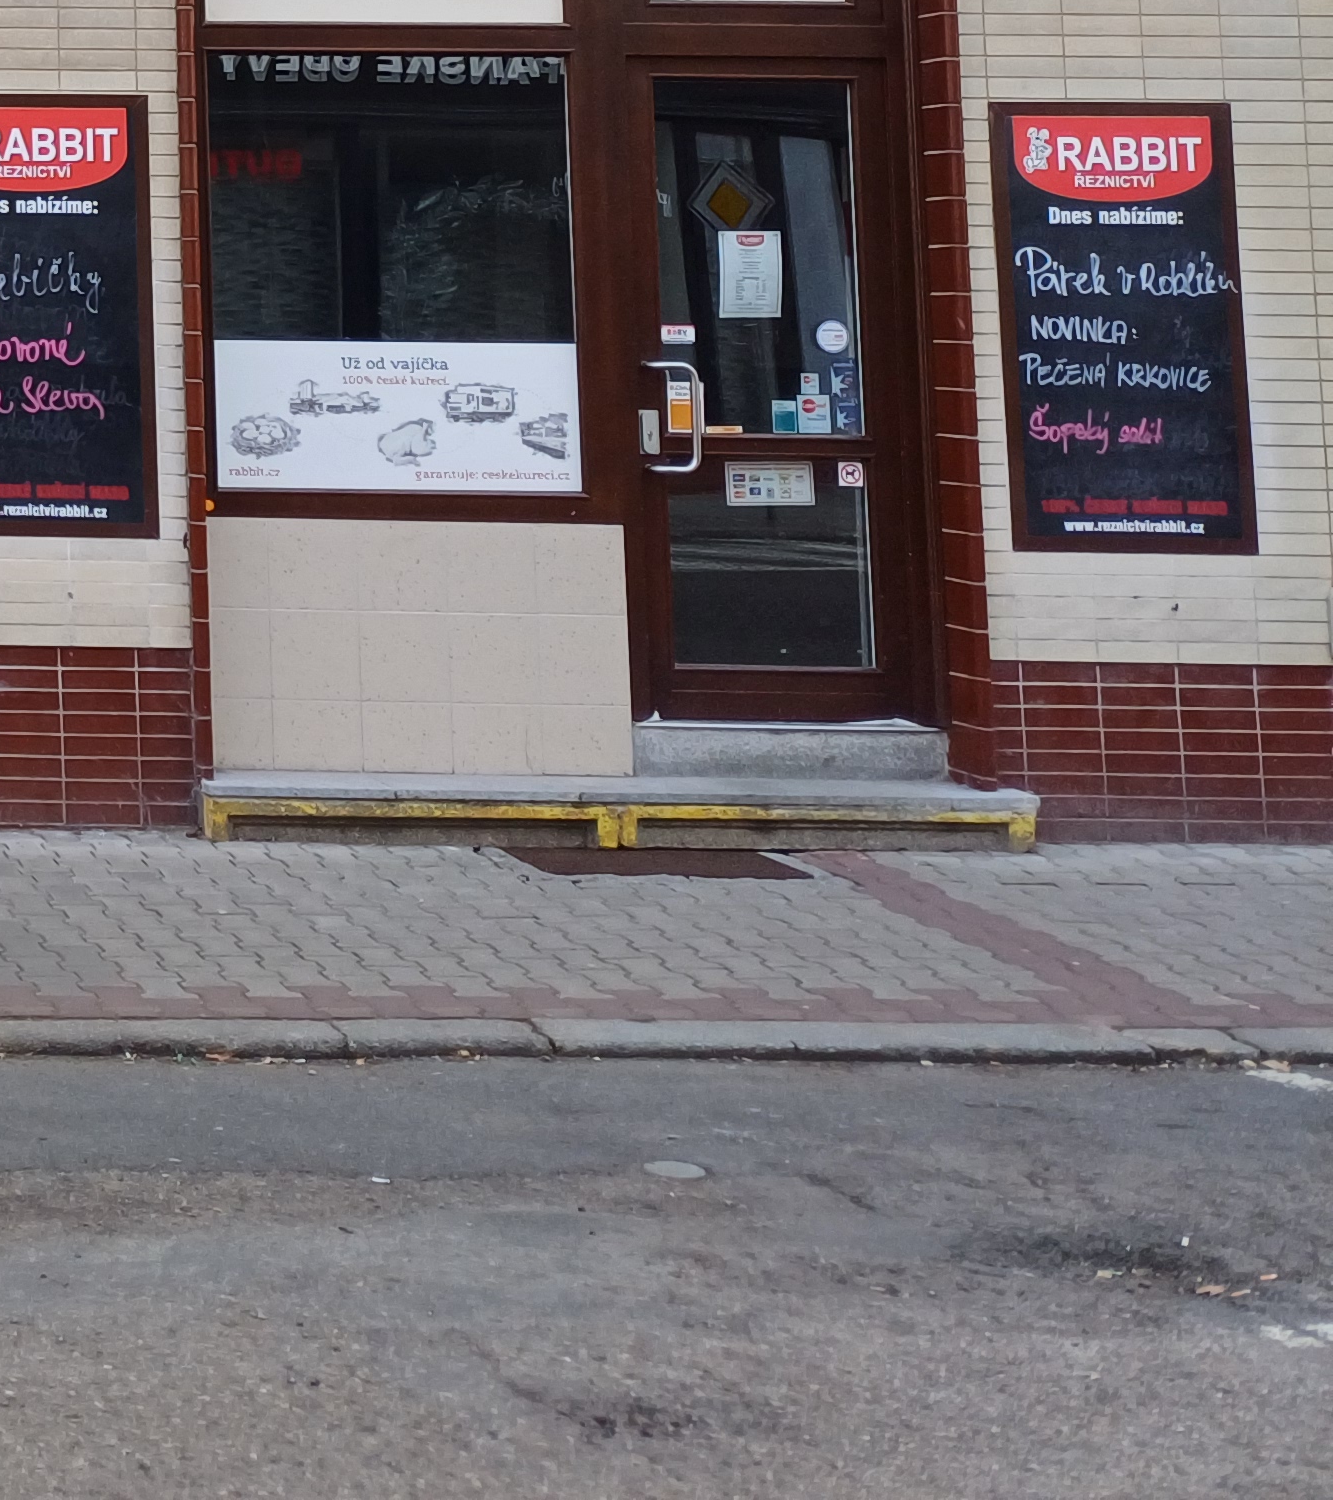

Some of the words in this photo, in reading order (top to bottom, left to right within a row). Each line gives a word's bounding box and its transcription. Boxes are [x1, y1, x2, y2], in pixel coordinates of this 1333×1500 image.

[1056, 136, 1202, 173] RABBIT
[1074, 172, 1155, 189] ŘEZNICTVÍ
[16, 196, 99, 215] nabízíme:
[1048, 205, 1092, 225] Dnes
[1099, 206, 1184, 226] nabízíme:
[1015, 246, 1111, 297] Párek
[1030, 315, 1140, 344] NOVINKA:
[340, 356, 361, 371] Už
[366, 356, 386, 371] od
[391, 356, 450, 375] vajíčka
[342, 375, 373, 385] 100%
[1117, 361, 1212, 392] KRKOVICE
